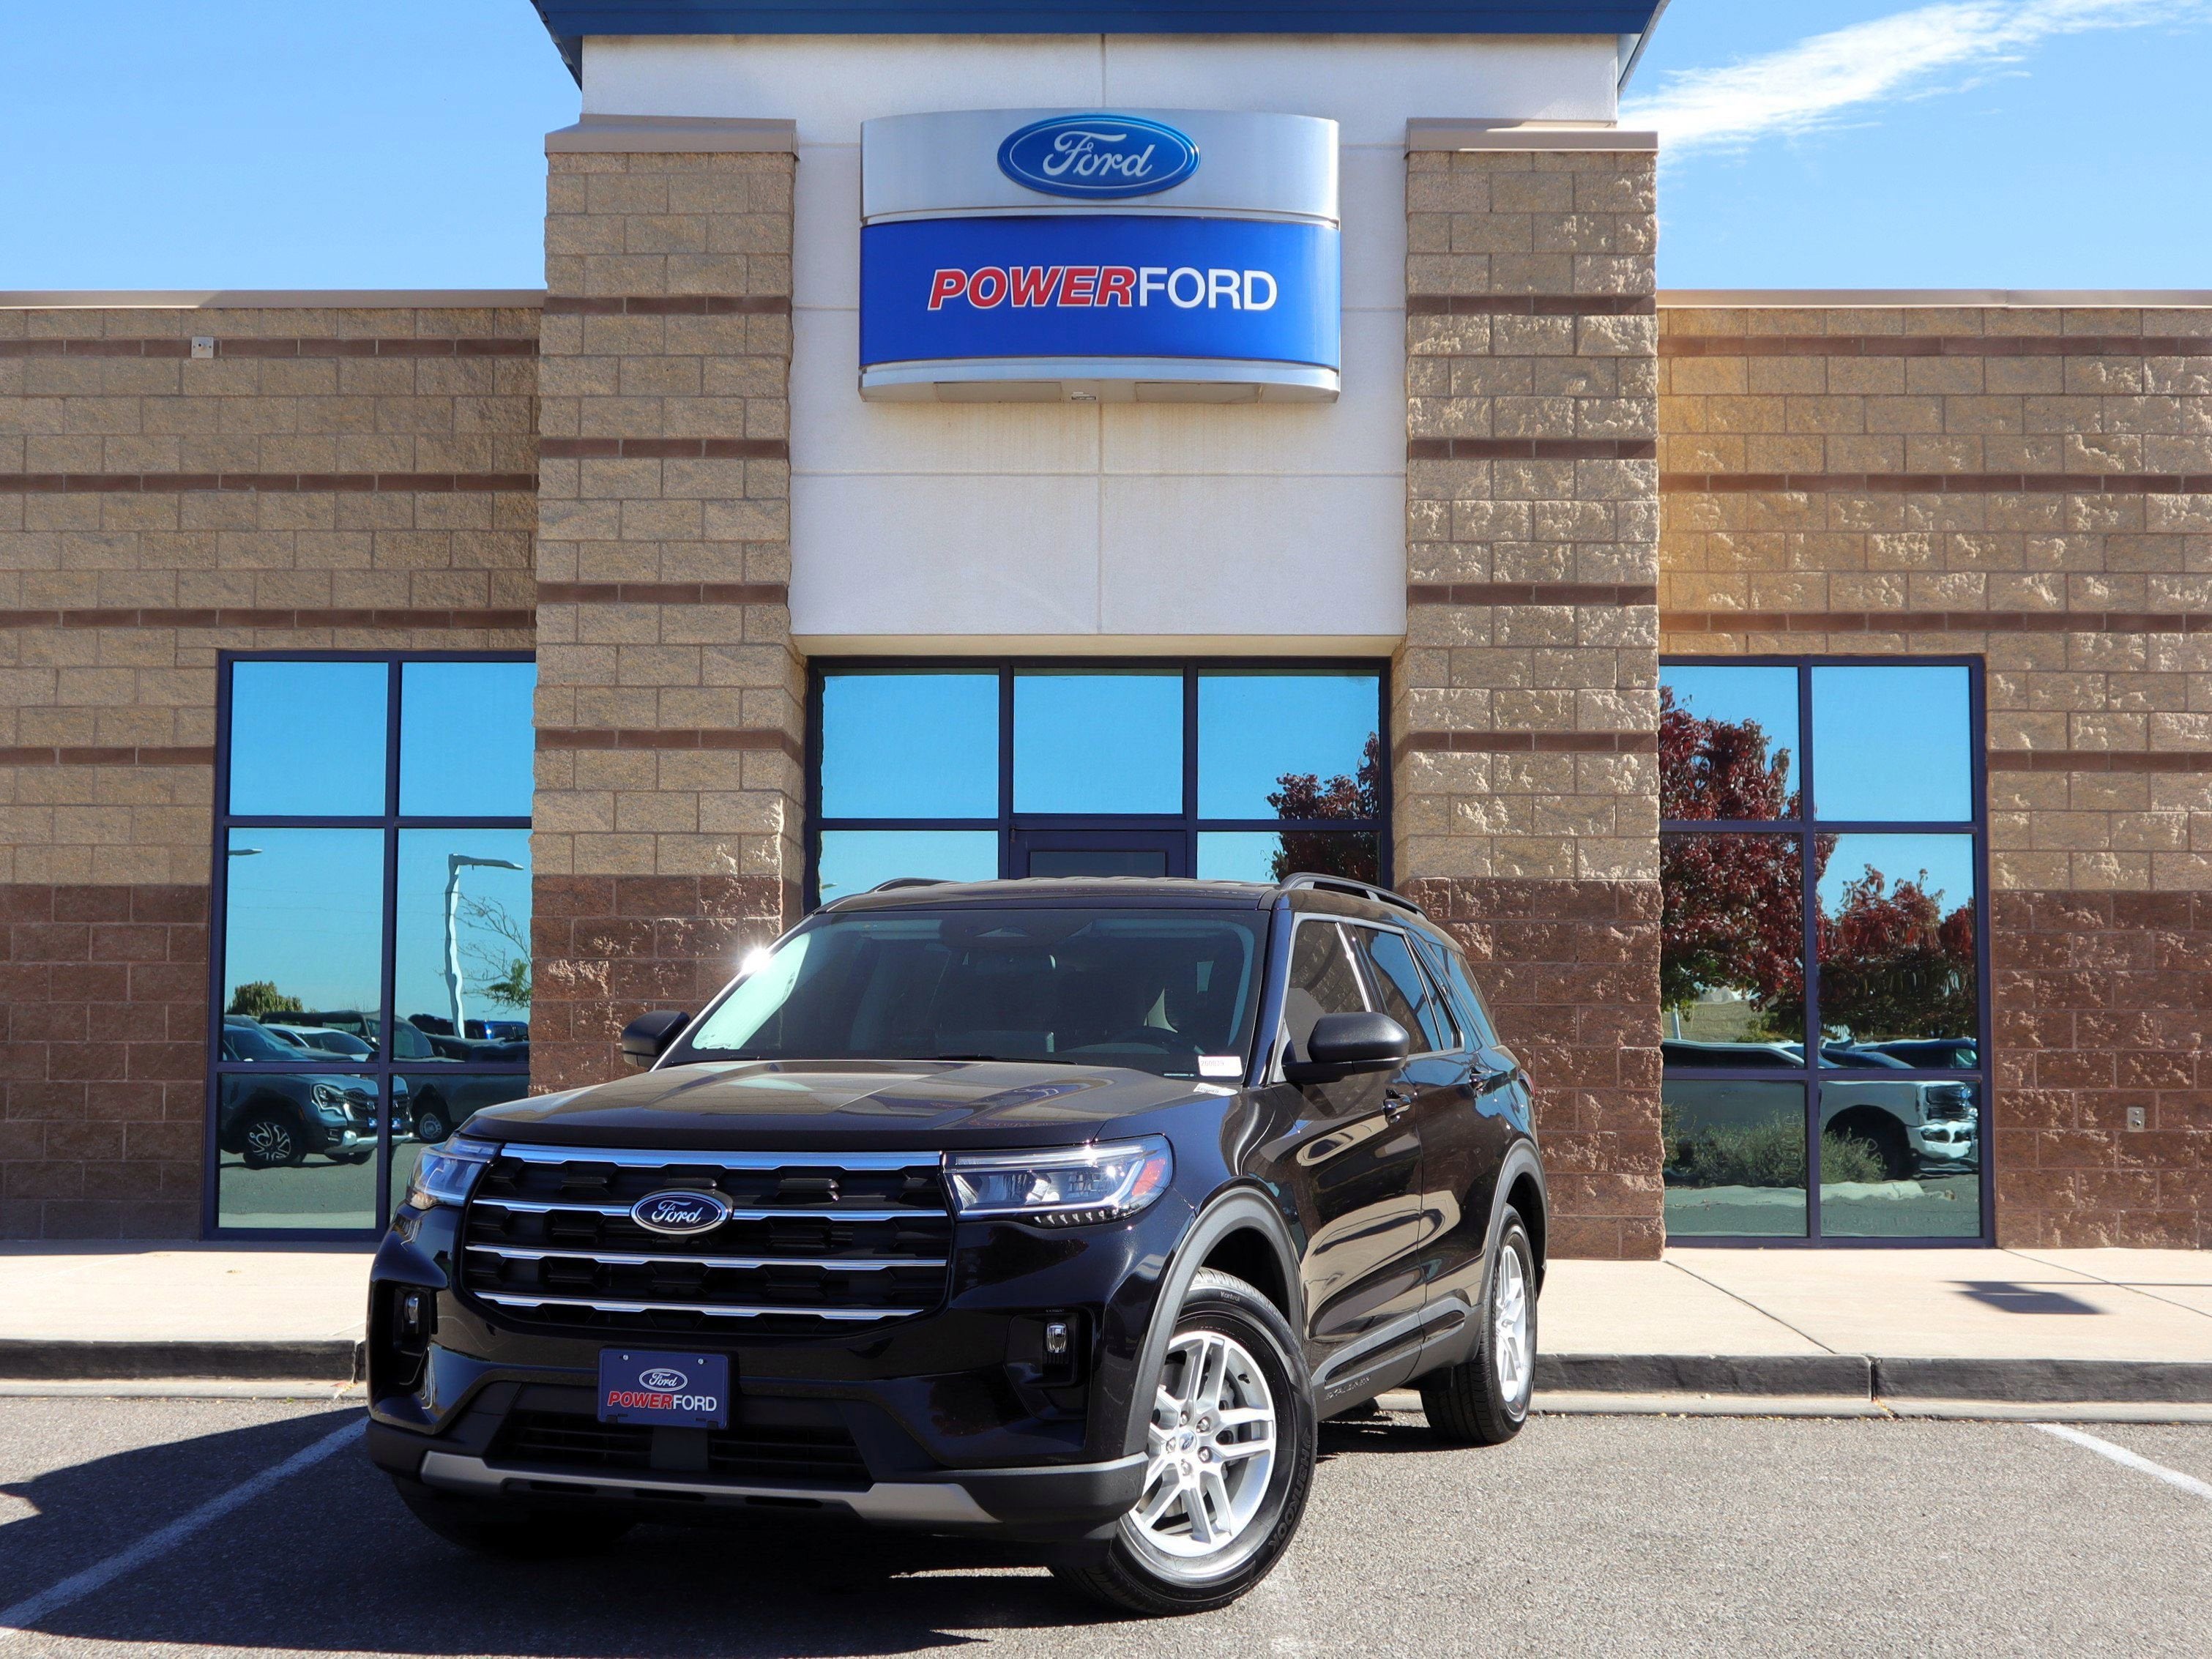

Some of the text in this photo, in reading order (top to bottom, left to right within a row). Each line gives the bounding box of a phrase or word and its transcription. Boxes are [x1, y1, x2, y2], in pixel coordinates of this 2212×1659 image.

[1043, 130, 1153, 177] Ford
[927, 265, 1278, 311] POWERFORD
[651, 1200, 703, 1223] Ford
[649, 1371, 679, 1387] Ford
[607, 1391, 718, 1412] POWERFORD
